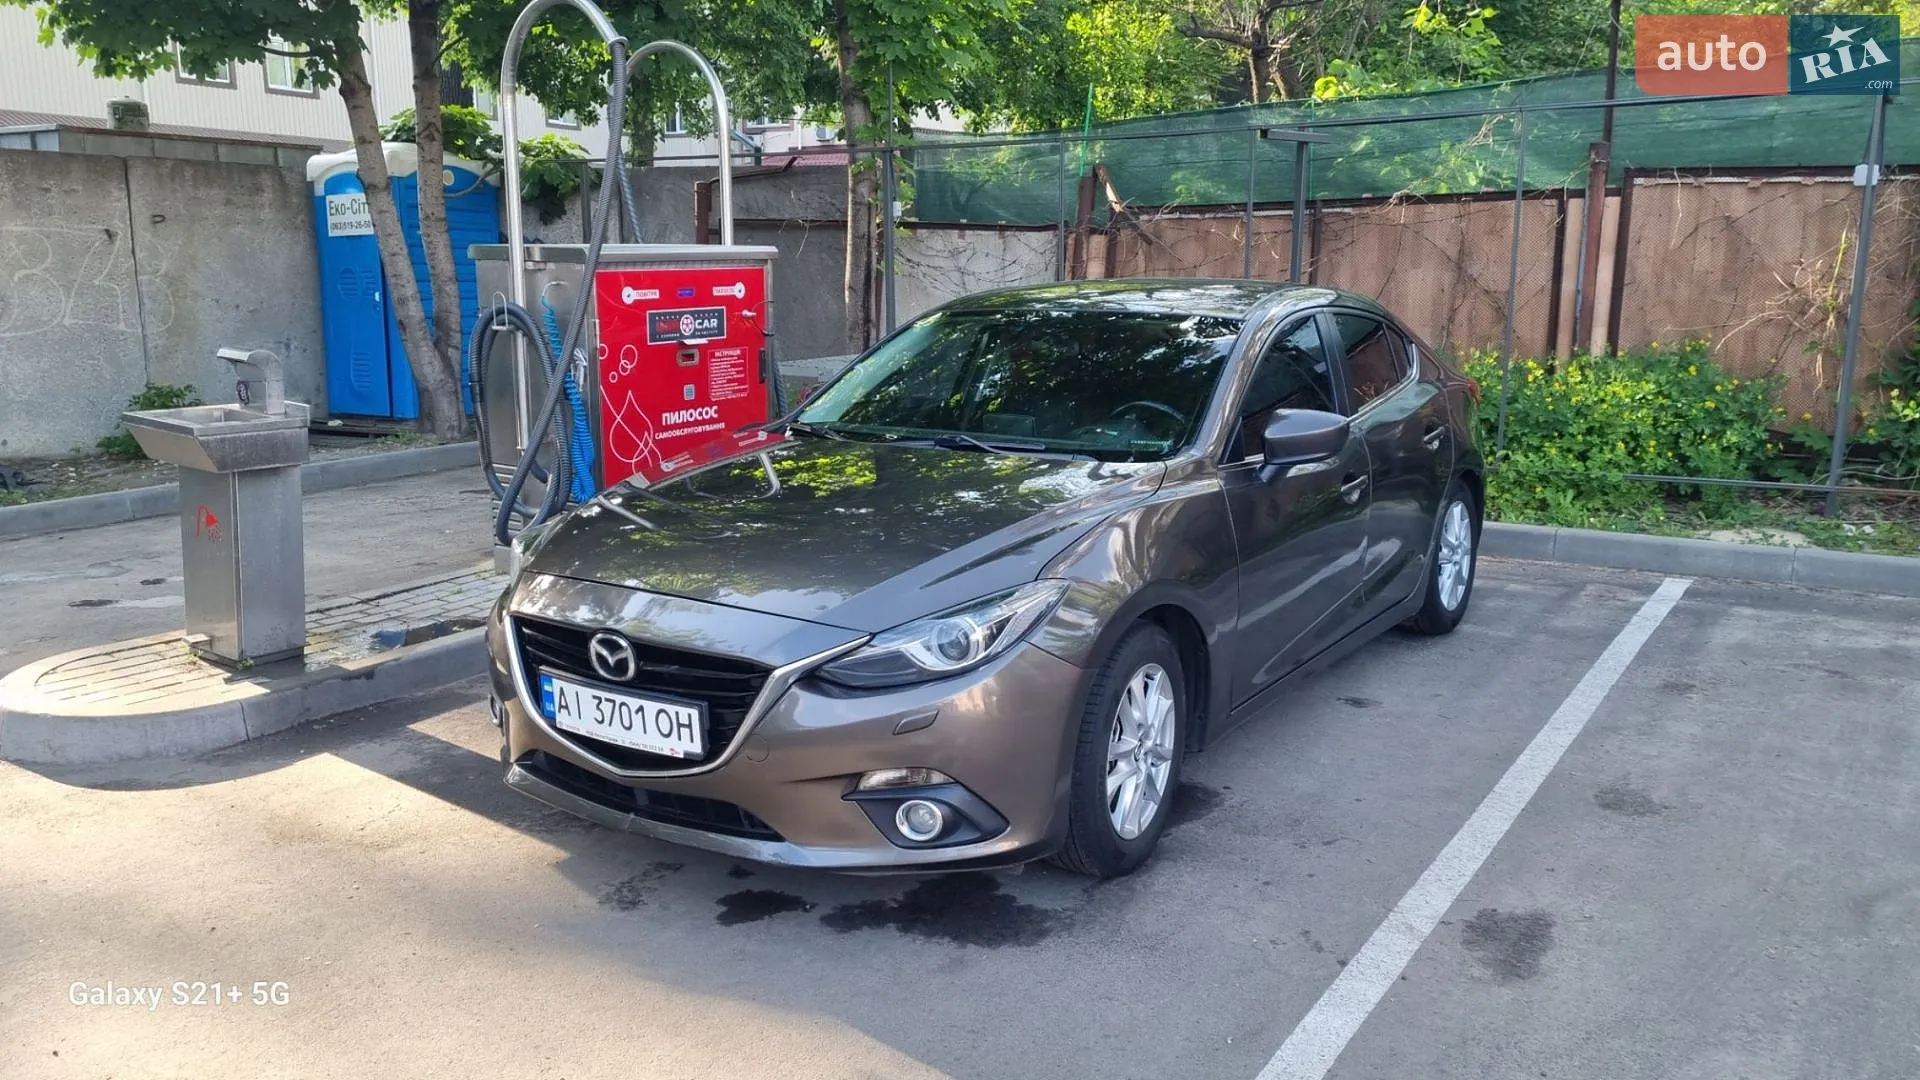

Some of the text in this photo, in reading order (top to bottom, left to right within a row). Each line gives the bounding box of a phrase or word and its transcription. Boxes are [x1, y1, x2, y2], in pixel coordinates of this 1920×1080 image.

[328, 198, 370, 217] Еко-Сіт
[695, 318, 718, 329] CAR
[662, 405, 718, 426] ПИЛОСОС
[592, 694, 648, 735] 3701
